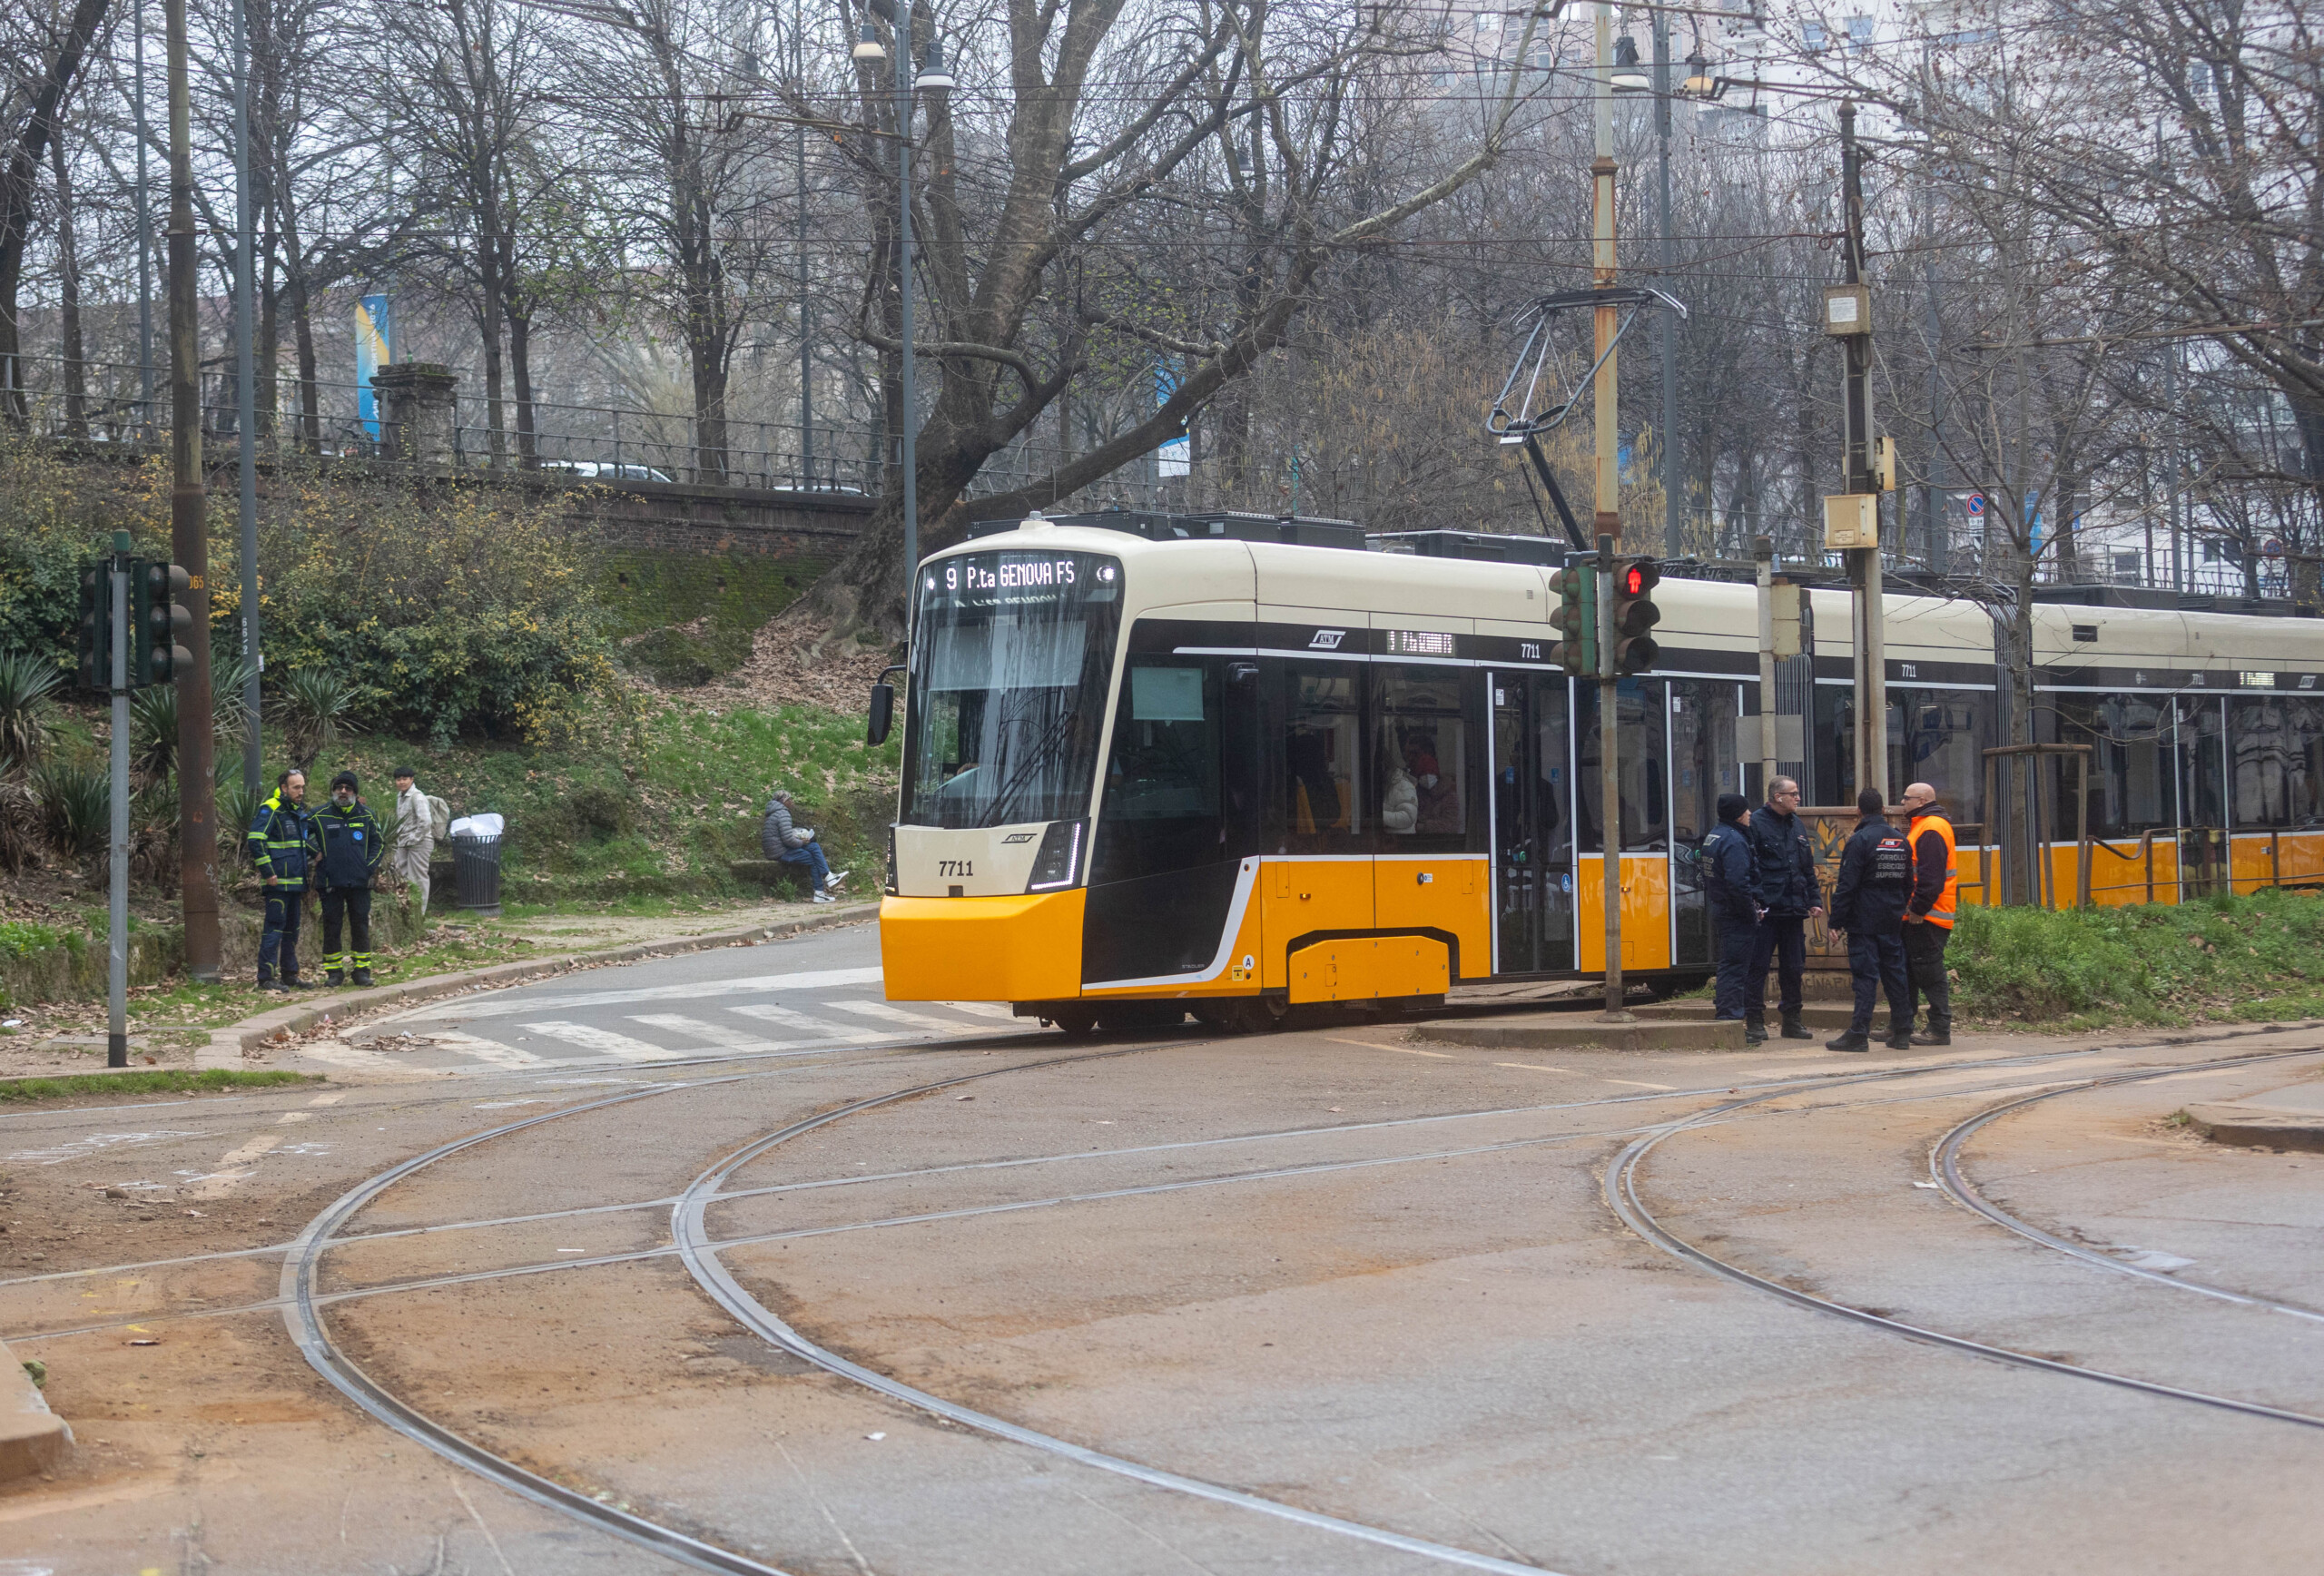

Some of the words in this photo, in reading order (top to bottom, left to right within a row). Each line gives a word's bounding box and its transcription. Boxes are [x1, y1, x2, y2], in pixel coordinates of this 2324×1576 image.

[946, 567, 958, 590] 9
[967, 566, 996, 589] P.ta
[1000, 562, 1053, 587] GENOVA
[1056, 560, 1076, 584] FS
[1521, 643, 1541, 659] 7711
[1901, 664, 1917, 678] 7711
[939, 860, 974, 877] 7711
[1245, 957, 1252, 968] A
